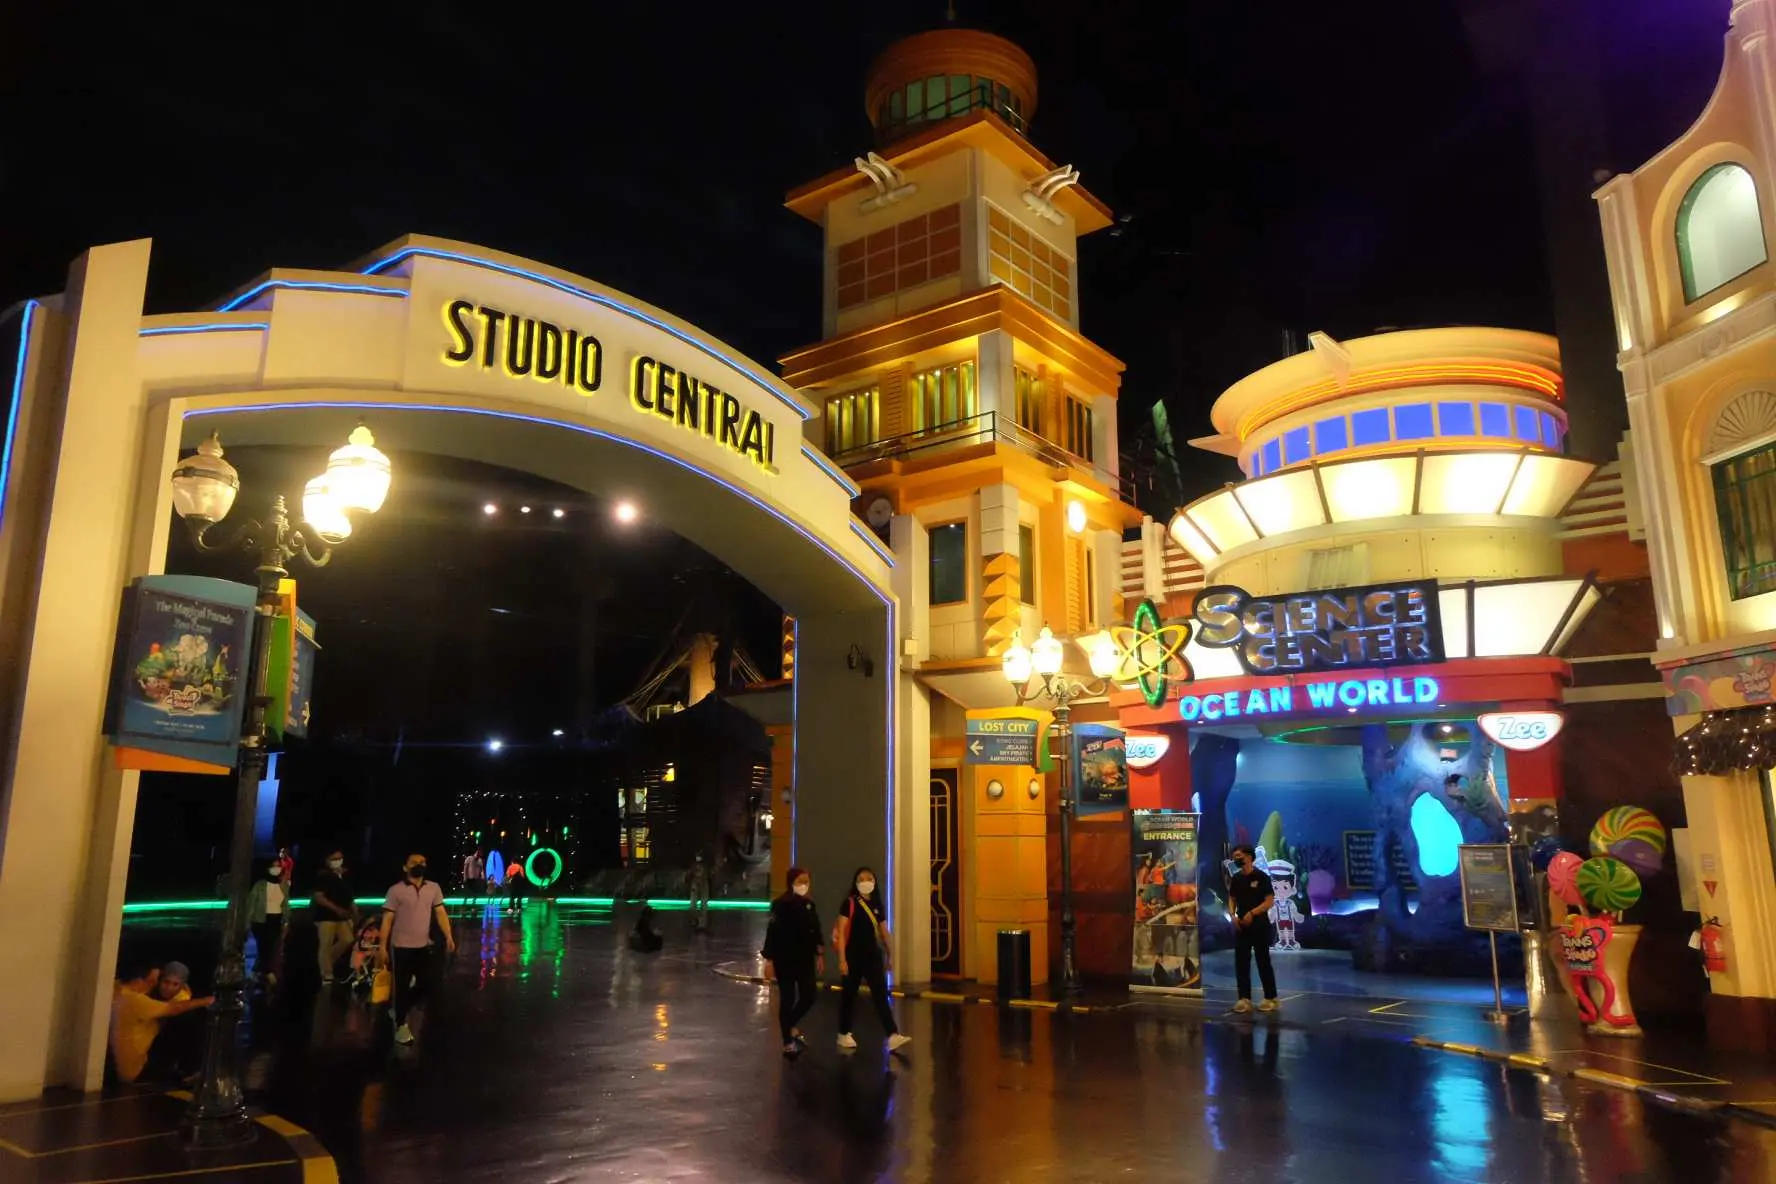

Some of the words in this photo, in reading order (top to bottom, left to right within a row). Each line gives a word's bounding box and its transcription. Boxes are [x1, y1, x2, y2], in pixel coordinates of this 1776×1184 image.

[442, 300, 602, 395] STUDIO
[630, 355, 778, 475] CENTRAL
[1196, 588, 1427, 643] SCIENCE
[1245, 625, 1431, 669] CENTER
[1179, 686, 1292, 720] OCEAN
[1306, 676, 1439, 708] WORLD
[979, 721, 1004, 732] LOST
[1007, 723, 1029, 733] CITY
[1498, 717, 1547, 740] Zee
[1143, 831, 1193, 841] ENTRANCE
